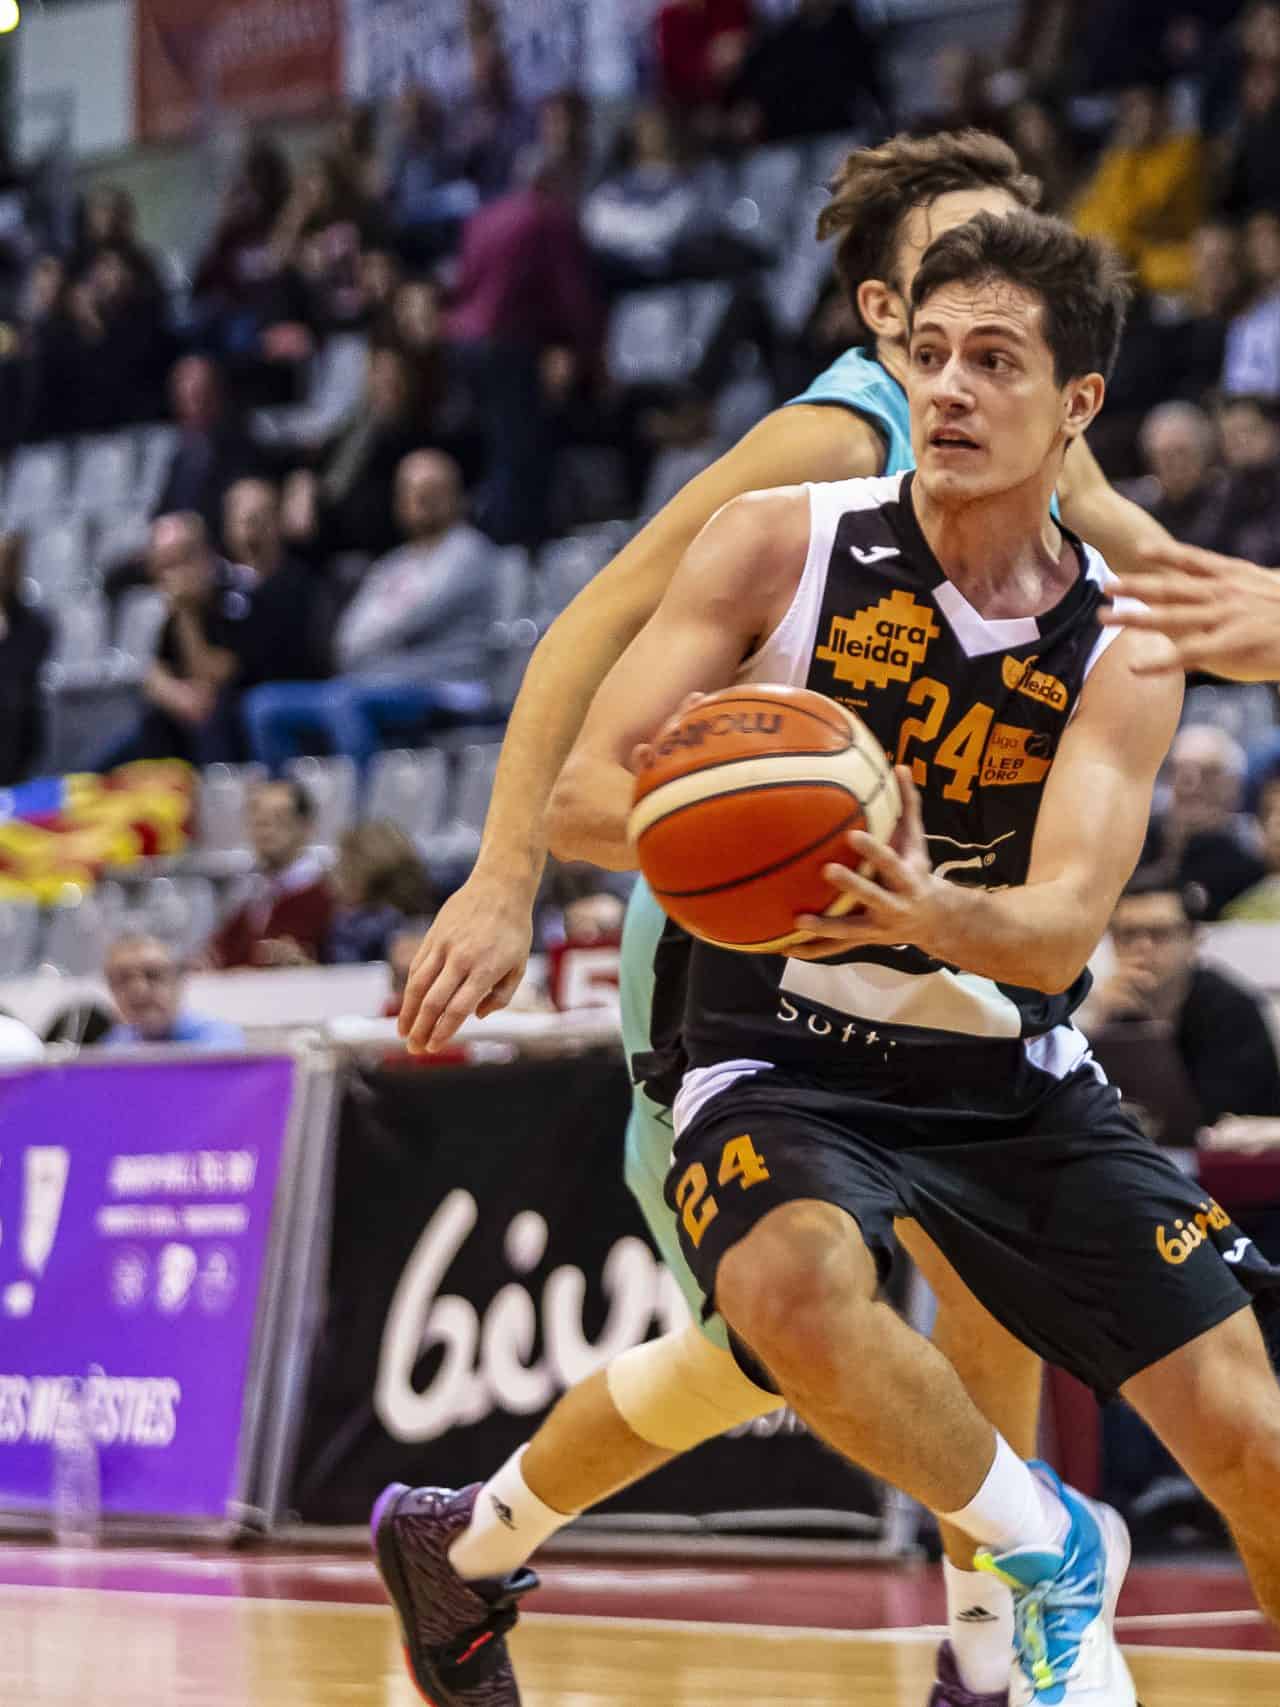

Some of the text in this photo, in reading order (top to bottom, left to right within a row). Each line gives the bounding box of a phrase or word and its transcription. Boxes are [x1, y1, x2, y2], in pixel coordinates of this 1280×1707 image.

[831, 628, 909, 667] lleida
[876, 620, 926, 645] ara
[895, 677, 995, 804] 24
[984, 768, 1019, 781] ORO
[987, 756, 1025, 770] LEB
[675, 1133, 770, 1250] 24
